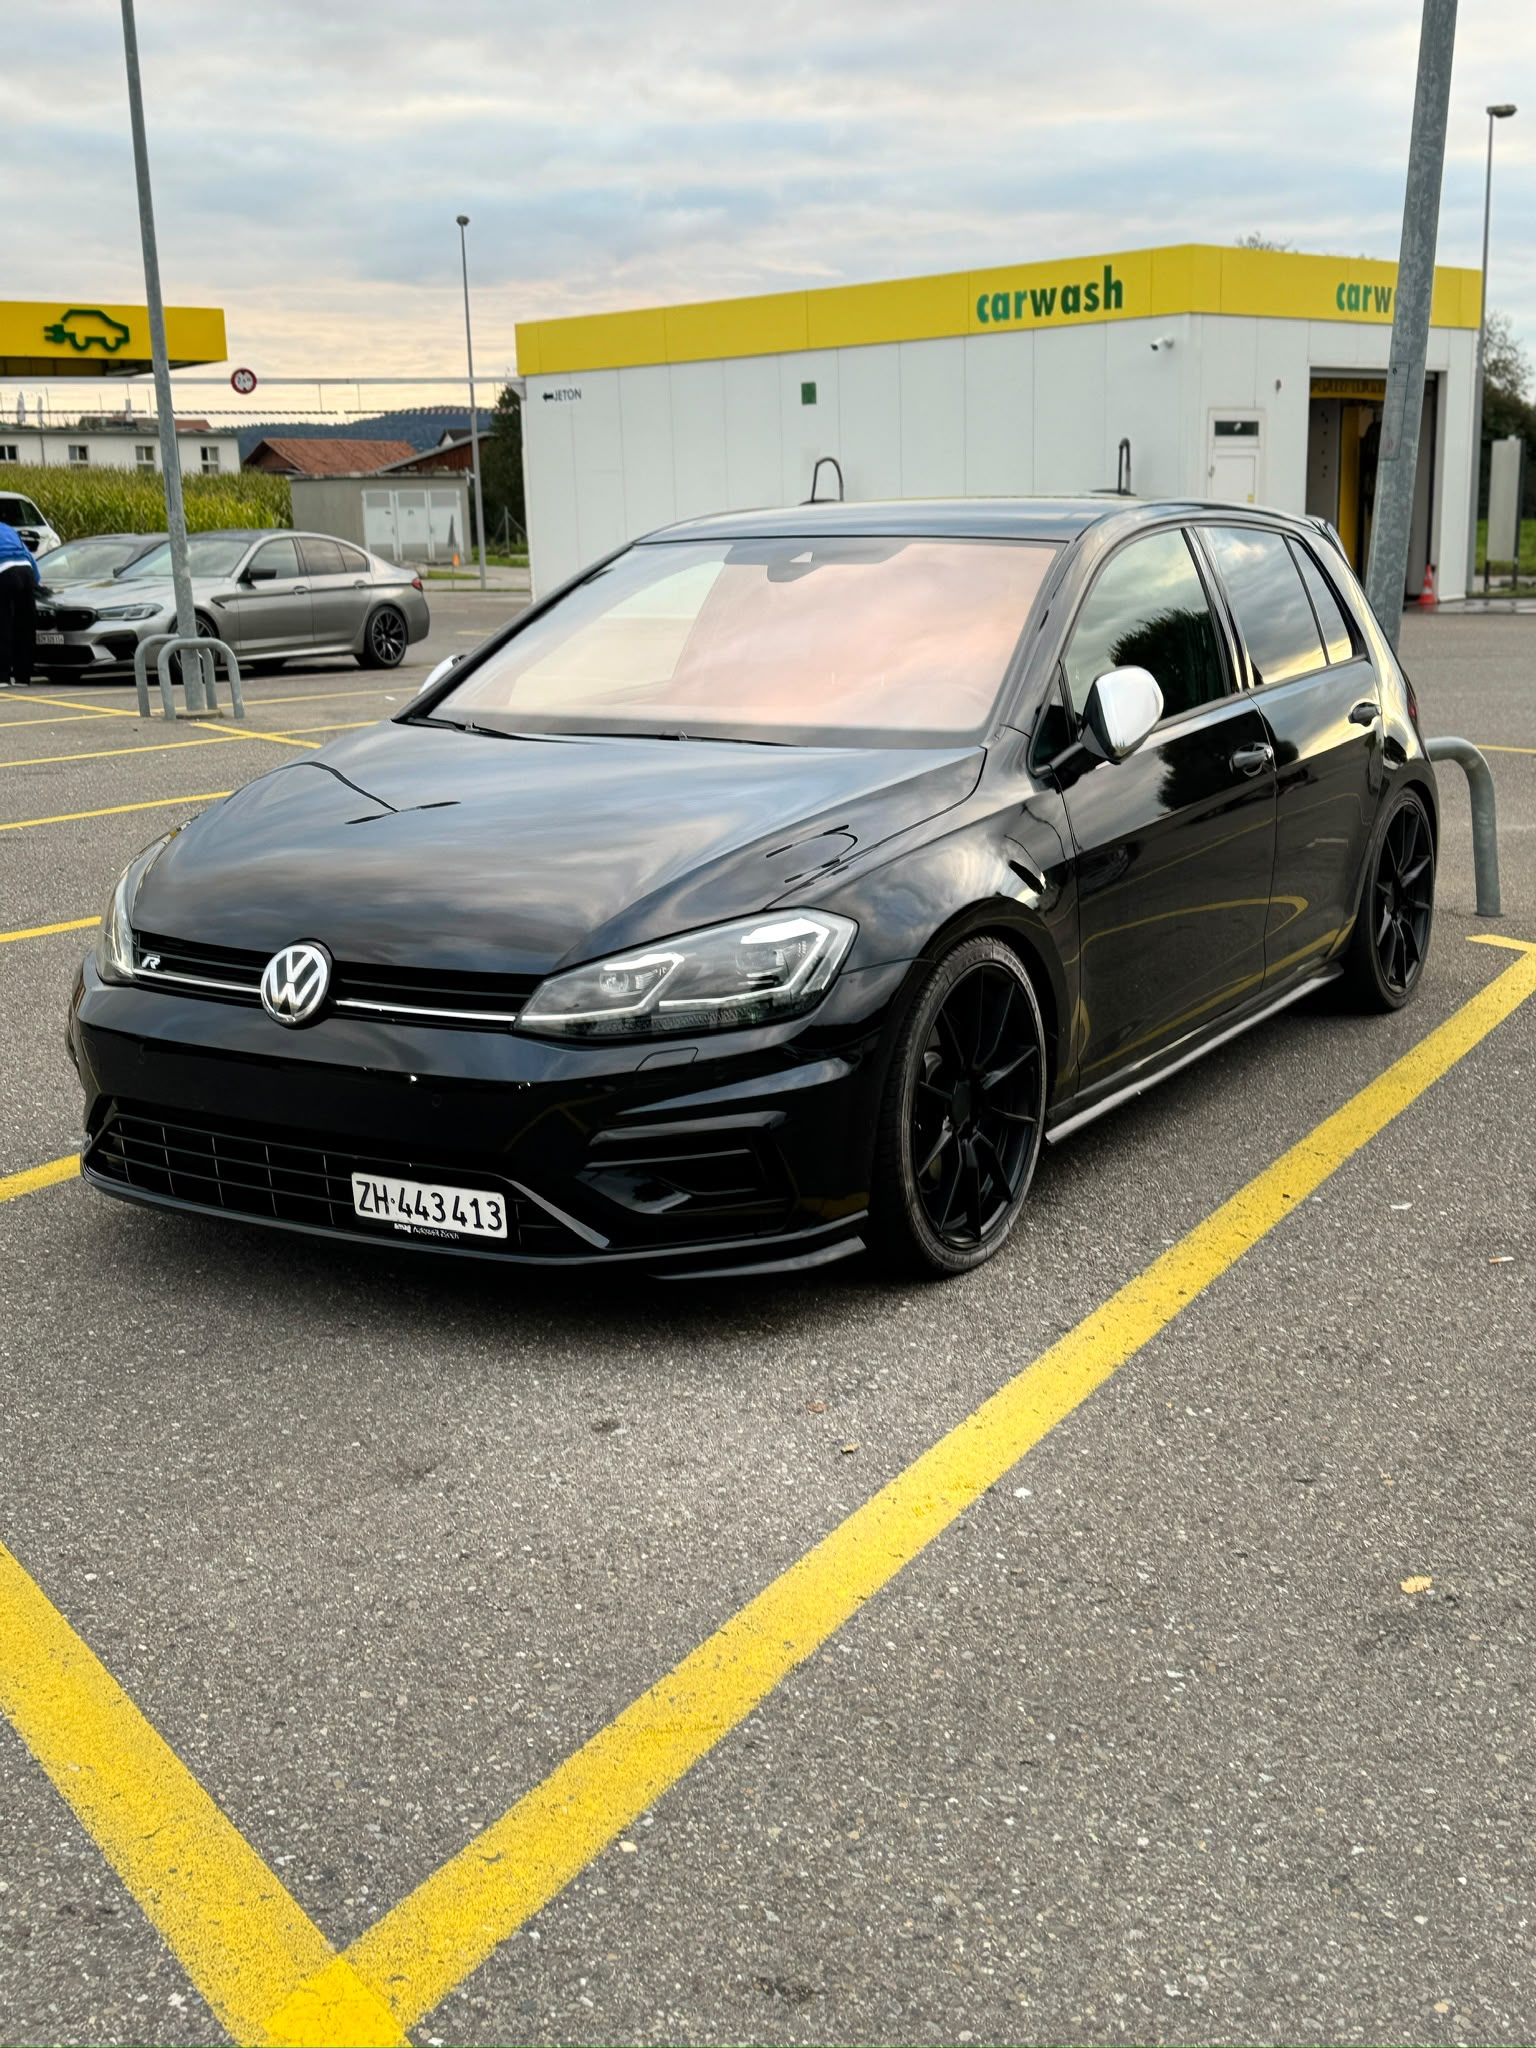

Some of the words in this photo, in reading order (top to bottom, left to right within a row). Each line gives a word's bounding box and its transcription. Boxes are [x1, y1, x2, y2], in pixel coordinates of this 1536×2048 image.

[976, 264, 1123, 324] carwash
[1336, 282, 1393, 313] carw
[554, 388, 582, 402] JETON
[141, 953, 161, 970] R
[264, 947, 324, 1019] VW
